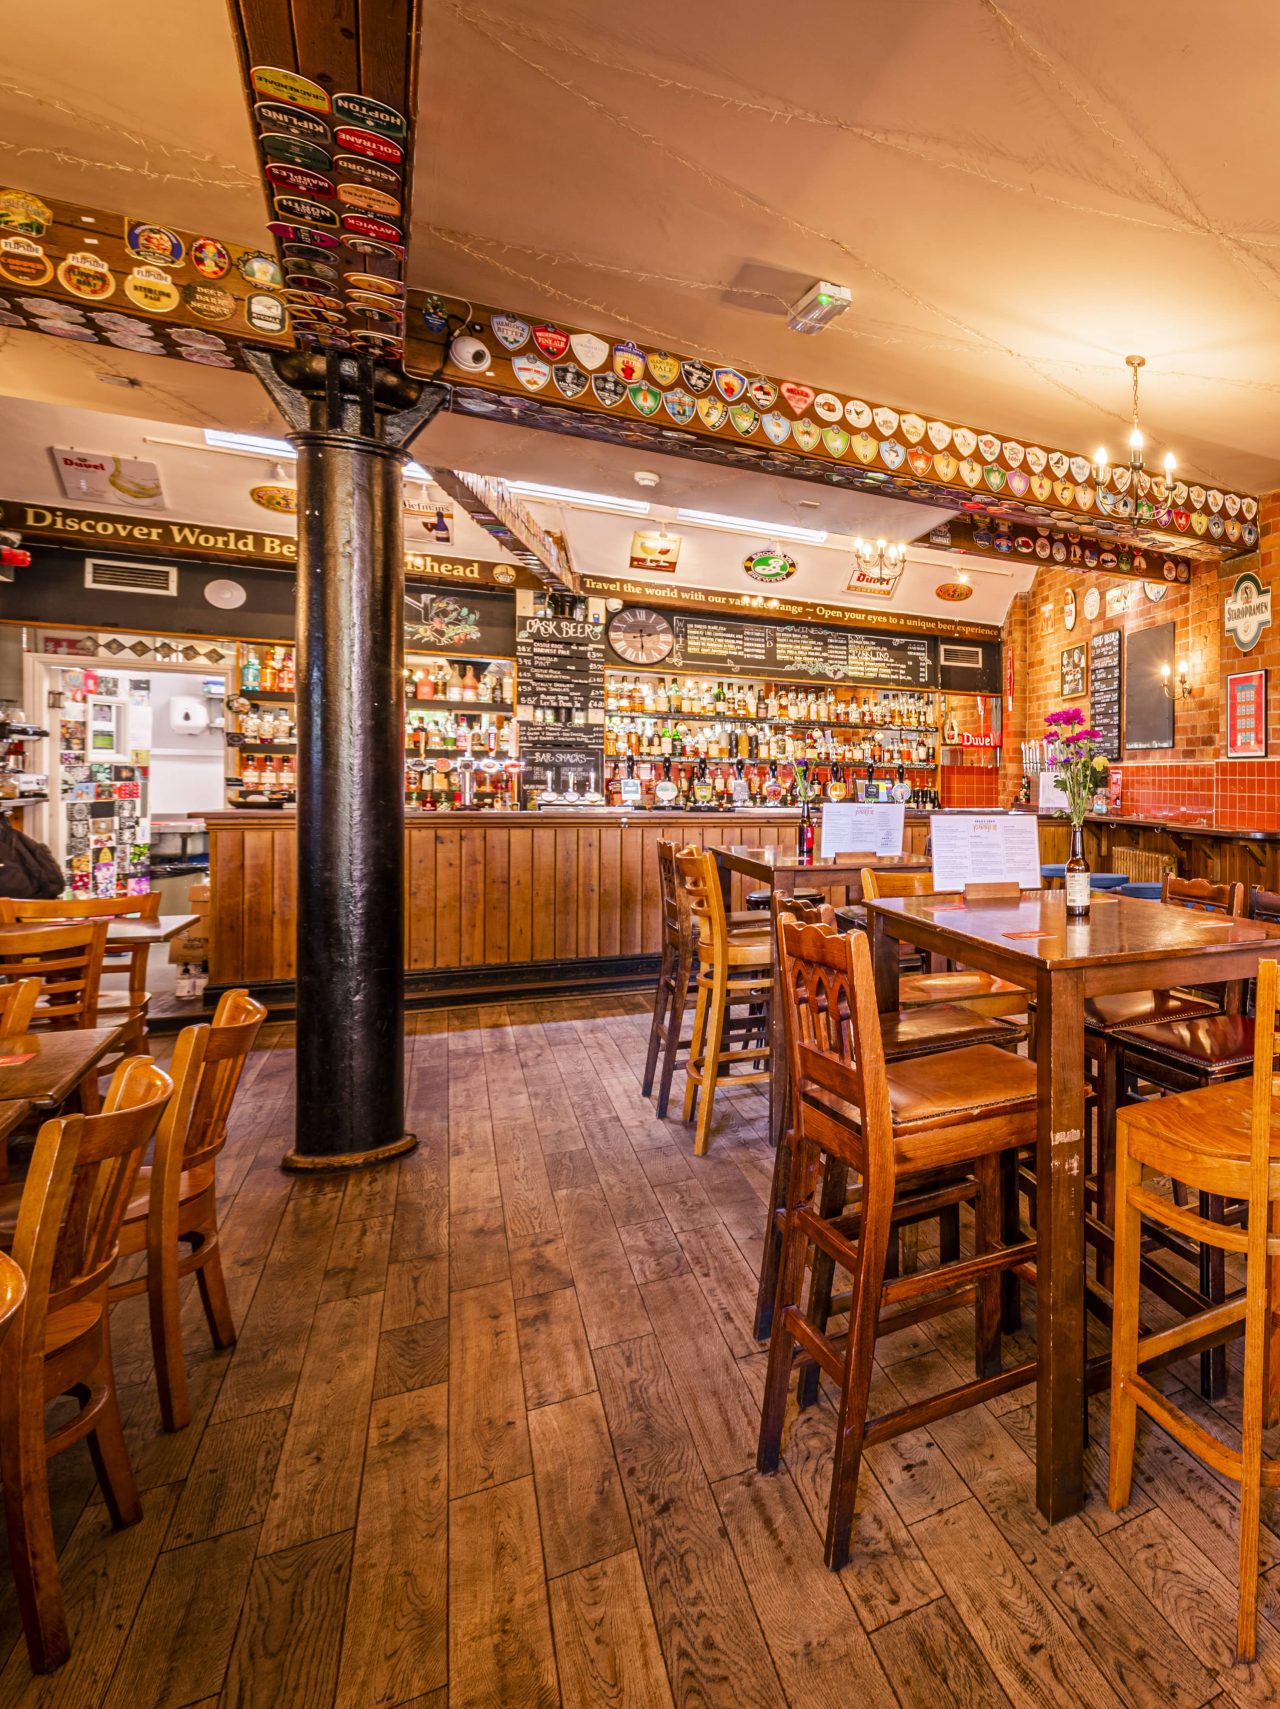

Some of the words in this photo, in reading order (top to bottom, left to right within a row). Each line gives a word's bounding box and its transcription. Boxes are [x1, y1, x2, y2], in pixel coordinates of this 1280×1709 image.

[338, 99, 401, 125] HOPTON
[262, 108, 324, 133] KIPLING
[339, 132, 400, 156] COLTRANE
[272, 167, 329, 188] MARPLES
[339, 160, 396, 182] ASHFORD
[283, 199, 331, 217] NORTH
[347, 219, 397, 236] JAYWICK
[4, 241, 39, 254] FLIPSIDE
[71, 255, 105, 269] FLIPSIDE
[137, 269, 168, 283] FLIPSIDE
[133, 285, 171, 299] STERLING
[191, 301, 230, 315] SECRET
[497, 328, 524, 338] BITTER
[553, 339, 566, 348] ALE
[653, 365, 673, 373] PALE
[63, 457, 105, 471] Duvel
[25, 507, 162, 542] Discover
[170, 525, 256, 553] World
[748, 572, 787, 583] BREWERY
[583, 578, 621, 592] Travel
[623, 582, 642, 594] the
[645, 586, 678, 598] world
[681, 590, 705, 602] with
[707, 595, 726, 604] our
[776, 602, 804, 614] range
[816, 606, 843, 620] Open
[844, 610, 867, 621] your
[867, 613, 888, 625] eyes
[889, 614, 898, 624] to
[906, 618, 936, 631] unique
[938, 620, 956, 631] beer
[956, 623, 998, 637] experience
[1227, 600, 1269, 623] STAROPRAMEN
[526, 619, 562, 638] CASK
[560, 621, 601, 640] BEER
[962, 731, 995, 747] Duvel
[534, 752, 555, 763] BAR
[555, 752, 587, 764] SNACKS
